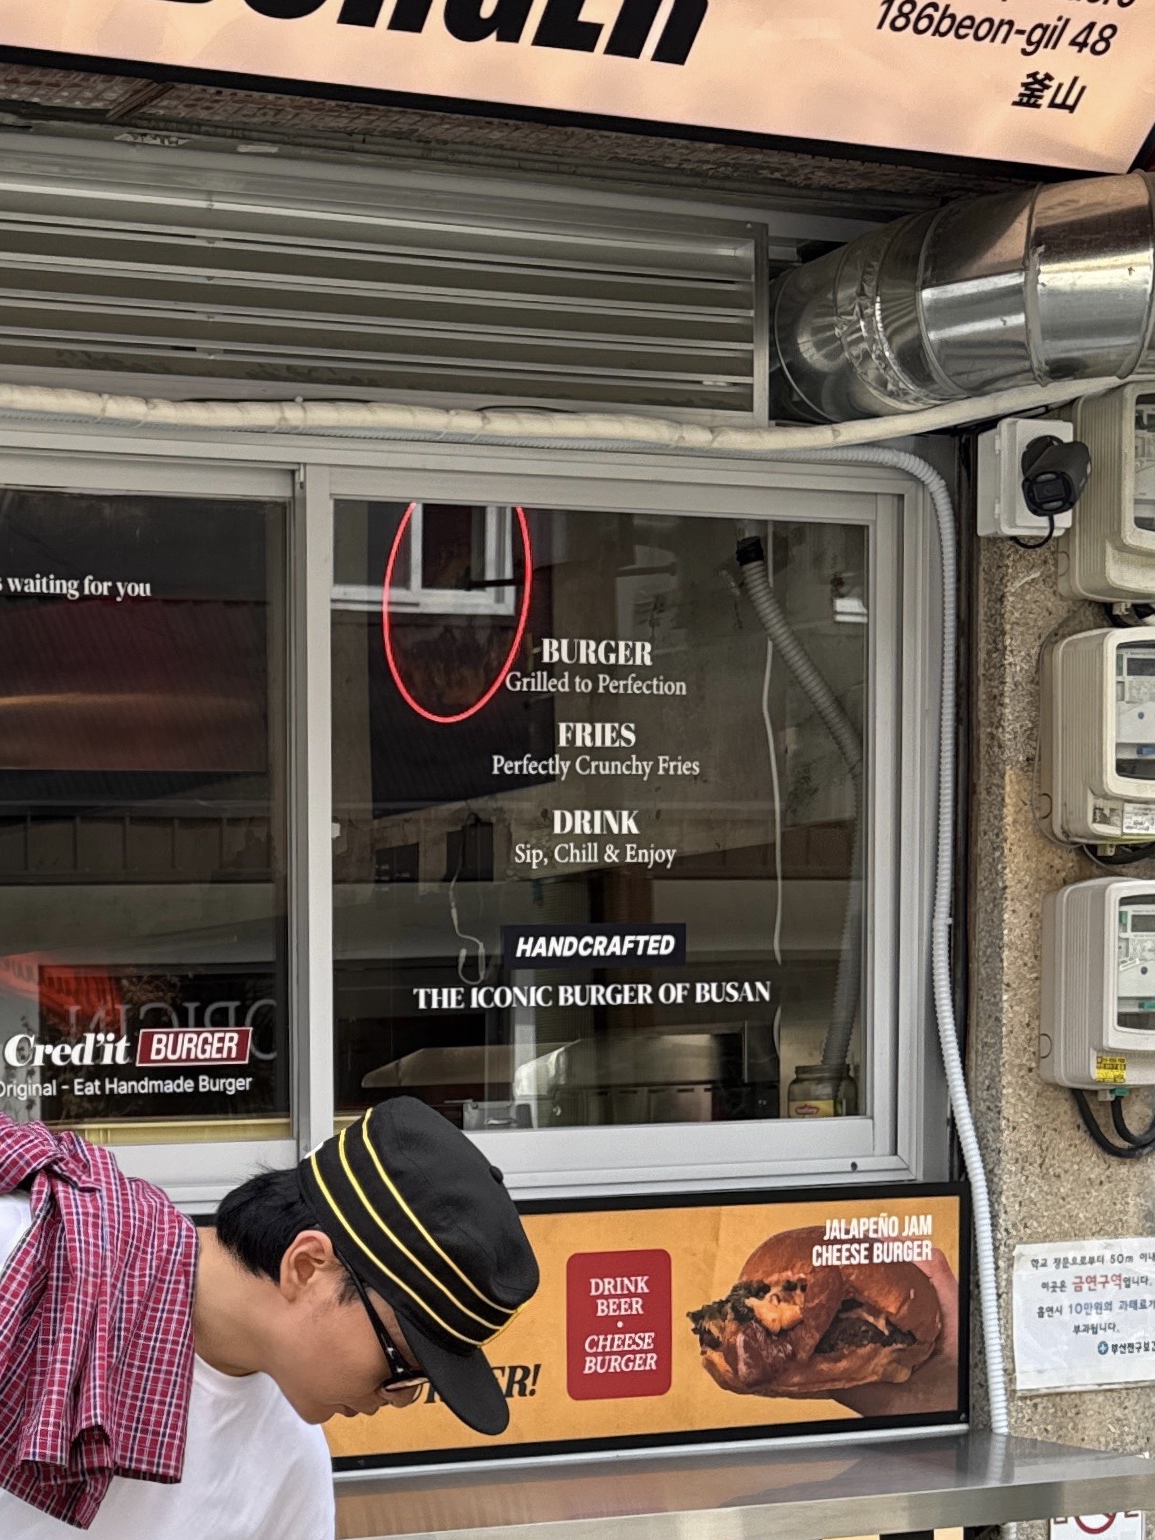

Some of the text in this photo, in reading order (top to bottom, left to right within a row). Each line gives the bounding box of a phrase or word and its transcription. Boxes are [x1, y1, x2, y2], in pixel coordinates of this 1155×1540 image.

[875, 0, 1118, 57] 186beon-gil 48
[1011, 71, 1087, 113] 釜山
[6, 573, 80, 600] waiting
[83, 574, 113, 596] for
[115, 581, 152, 602] you
[542, 638, 653, 666] BURGER
[505, 672, 687, 696] Grilled to Perfection
[558, 722, 636, 748] FRIES
[492, 753, 700, 782] Perfectly Crunchy Fries
[553, 809, 640, 835] DRINK
[514, 842, 677, 869] Sip, Chill & Enjoy
[515, 934, 676, 958] HANDCRAFTED
[412, 981, 771, 1009] THE ICONIC BURGER OF BUSAN
[3, 1030, 240, 1068] Cred'it BURGER
[73, 1077, 102, 1096] Eat
[105, 1074, 195, 1095] Handmade
[198, 1073, 253, 1096] Burger
[823, 1212, 933, 1241] JALAPEÑO JAM
[812, 1239, 933, 1267] CHEESE BURGER
[589, 1275, 650, 1297] DRINK
[596, 1297, 644, 1317] BEER
[584, 1331, 656, 1354] CHEESE
[582, 1352, 658, 1374] BURGER
